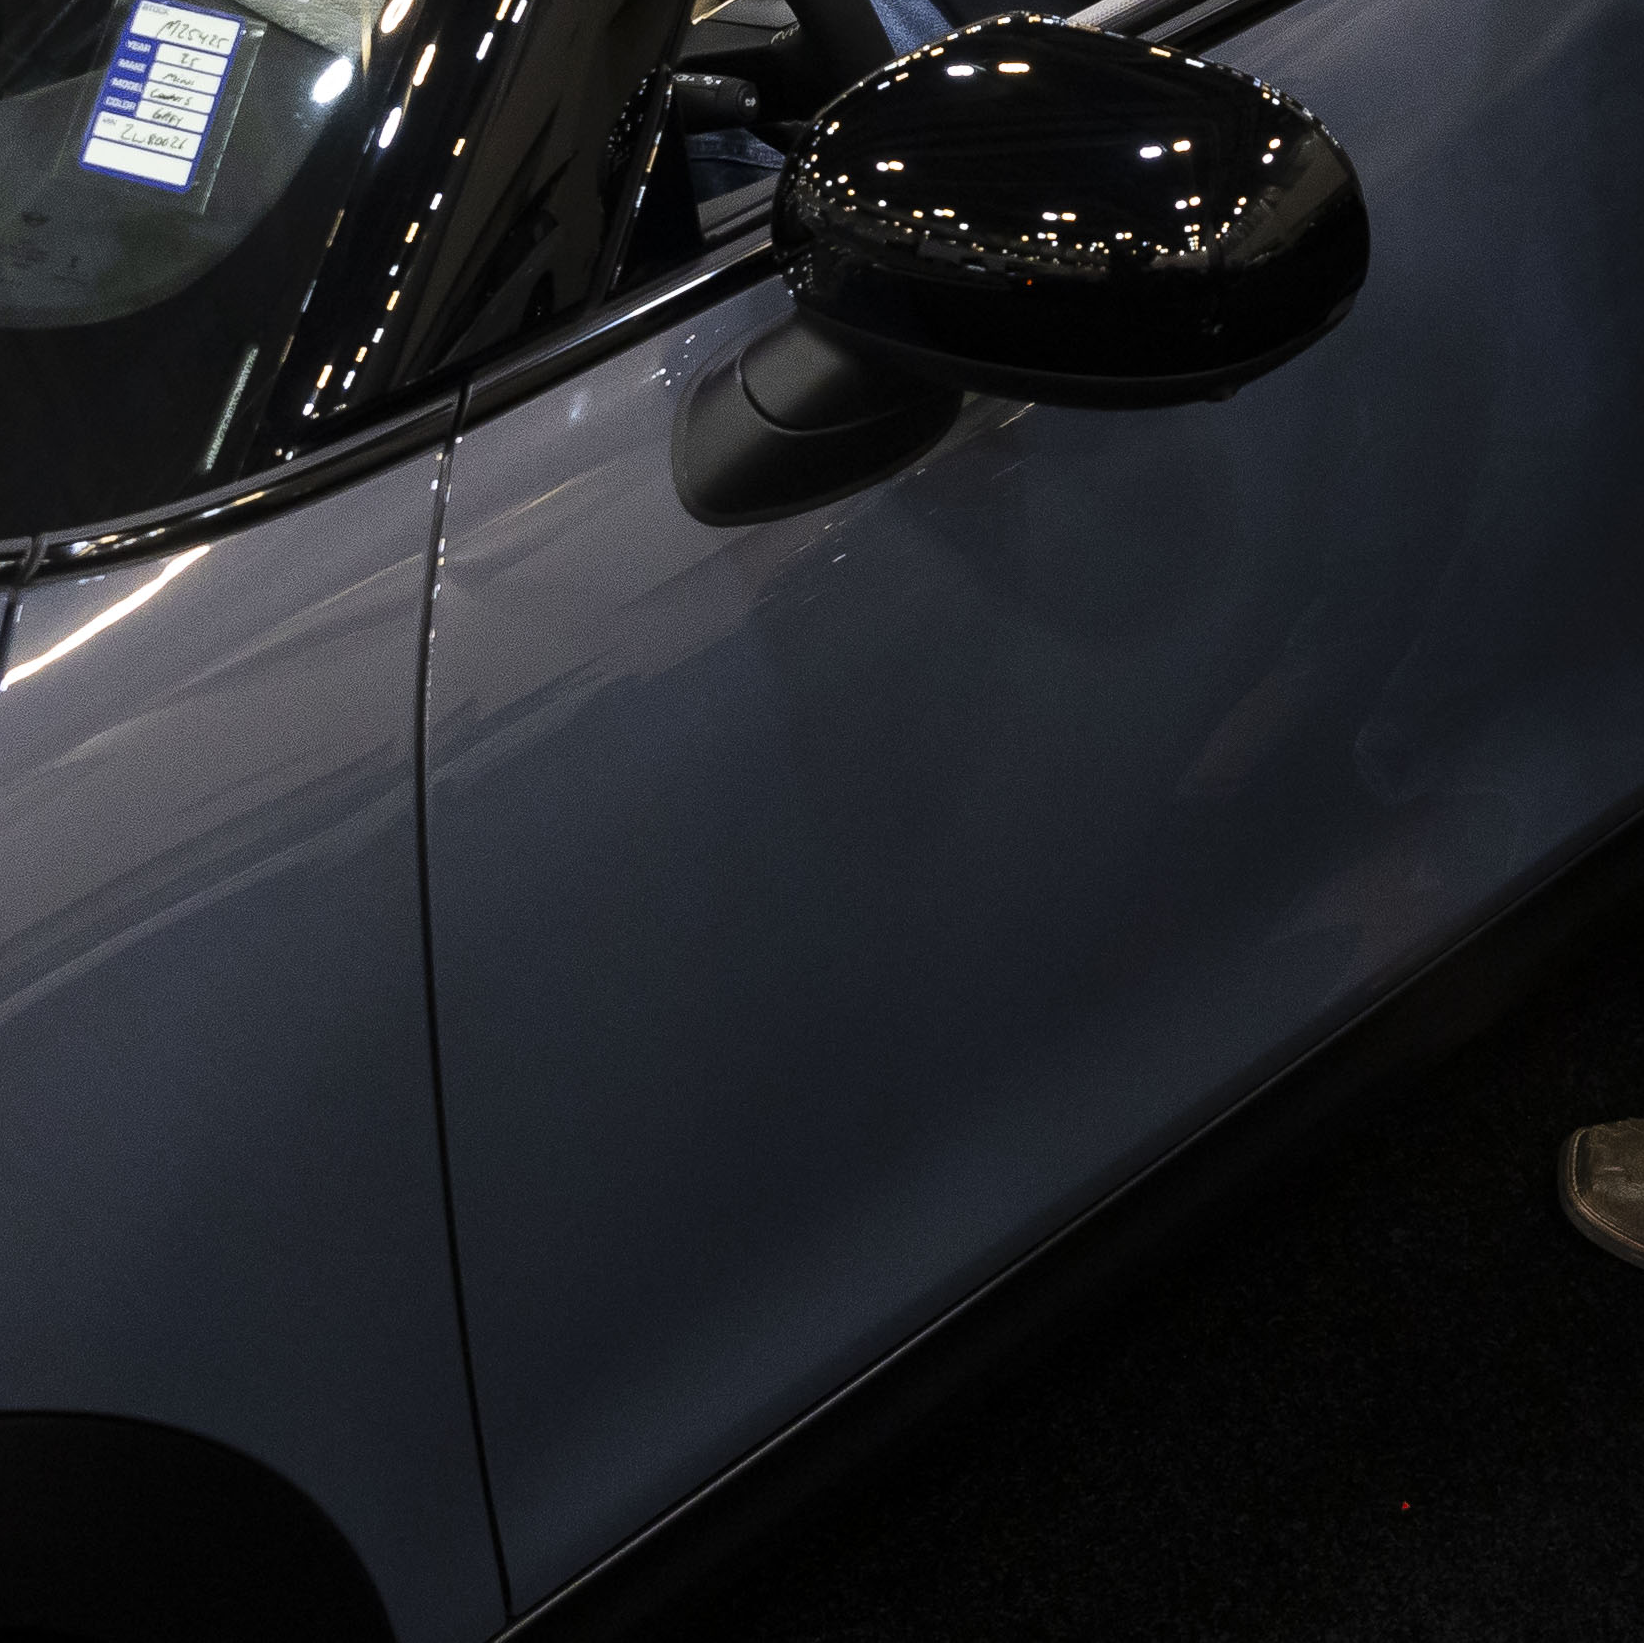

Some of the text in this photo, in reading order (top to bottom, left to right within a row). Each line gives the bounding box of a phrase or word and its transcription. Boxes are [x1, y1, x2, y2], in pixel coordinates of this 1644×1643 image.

[142, 5, 170, 16] STOCK
[126, 39, 152, 53] YEAR
[117, 58, 147, 74] MAKE
[180, 53, 202, 68] 25
[110, 77, 144, 93] MODEL
[104, 96, 138, 111] COLOR
[102, 116, 118, 126] VIN
